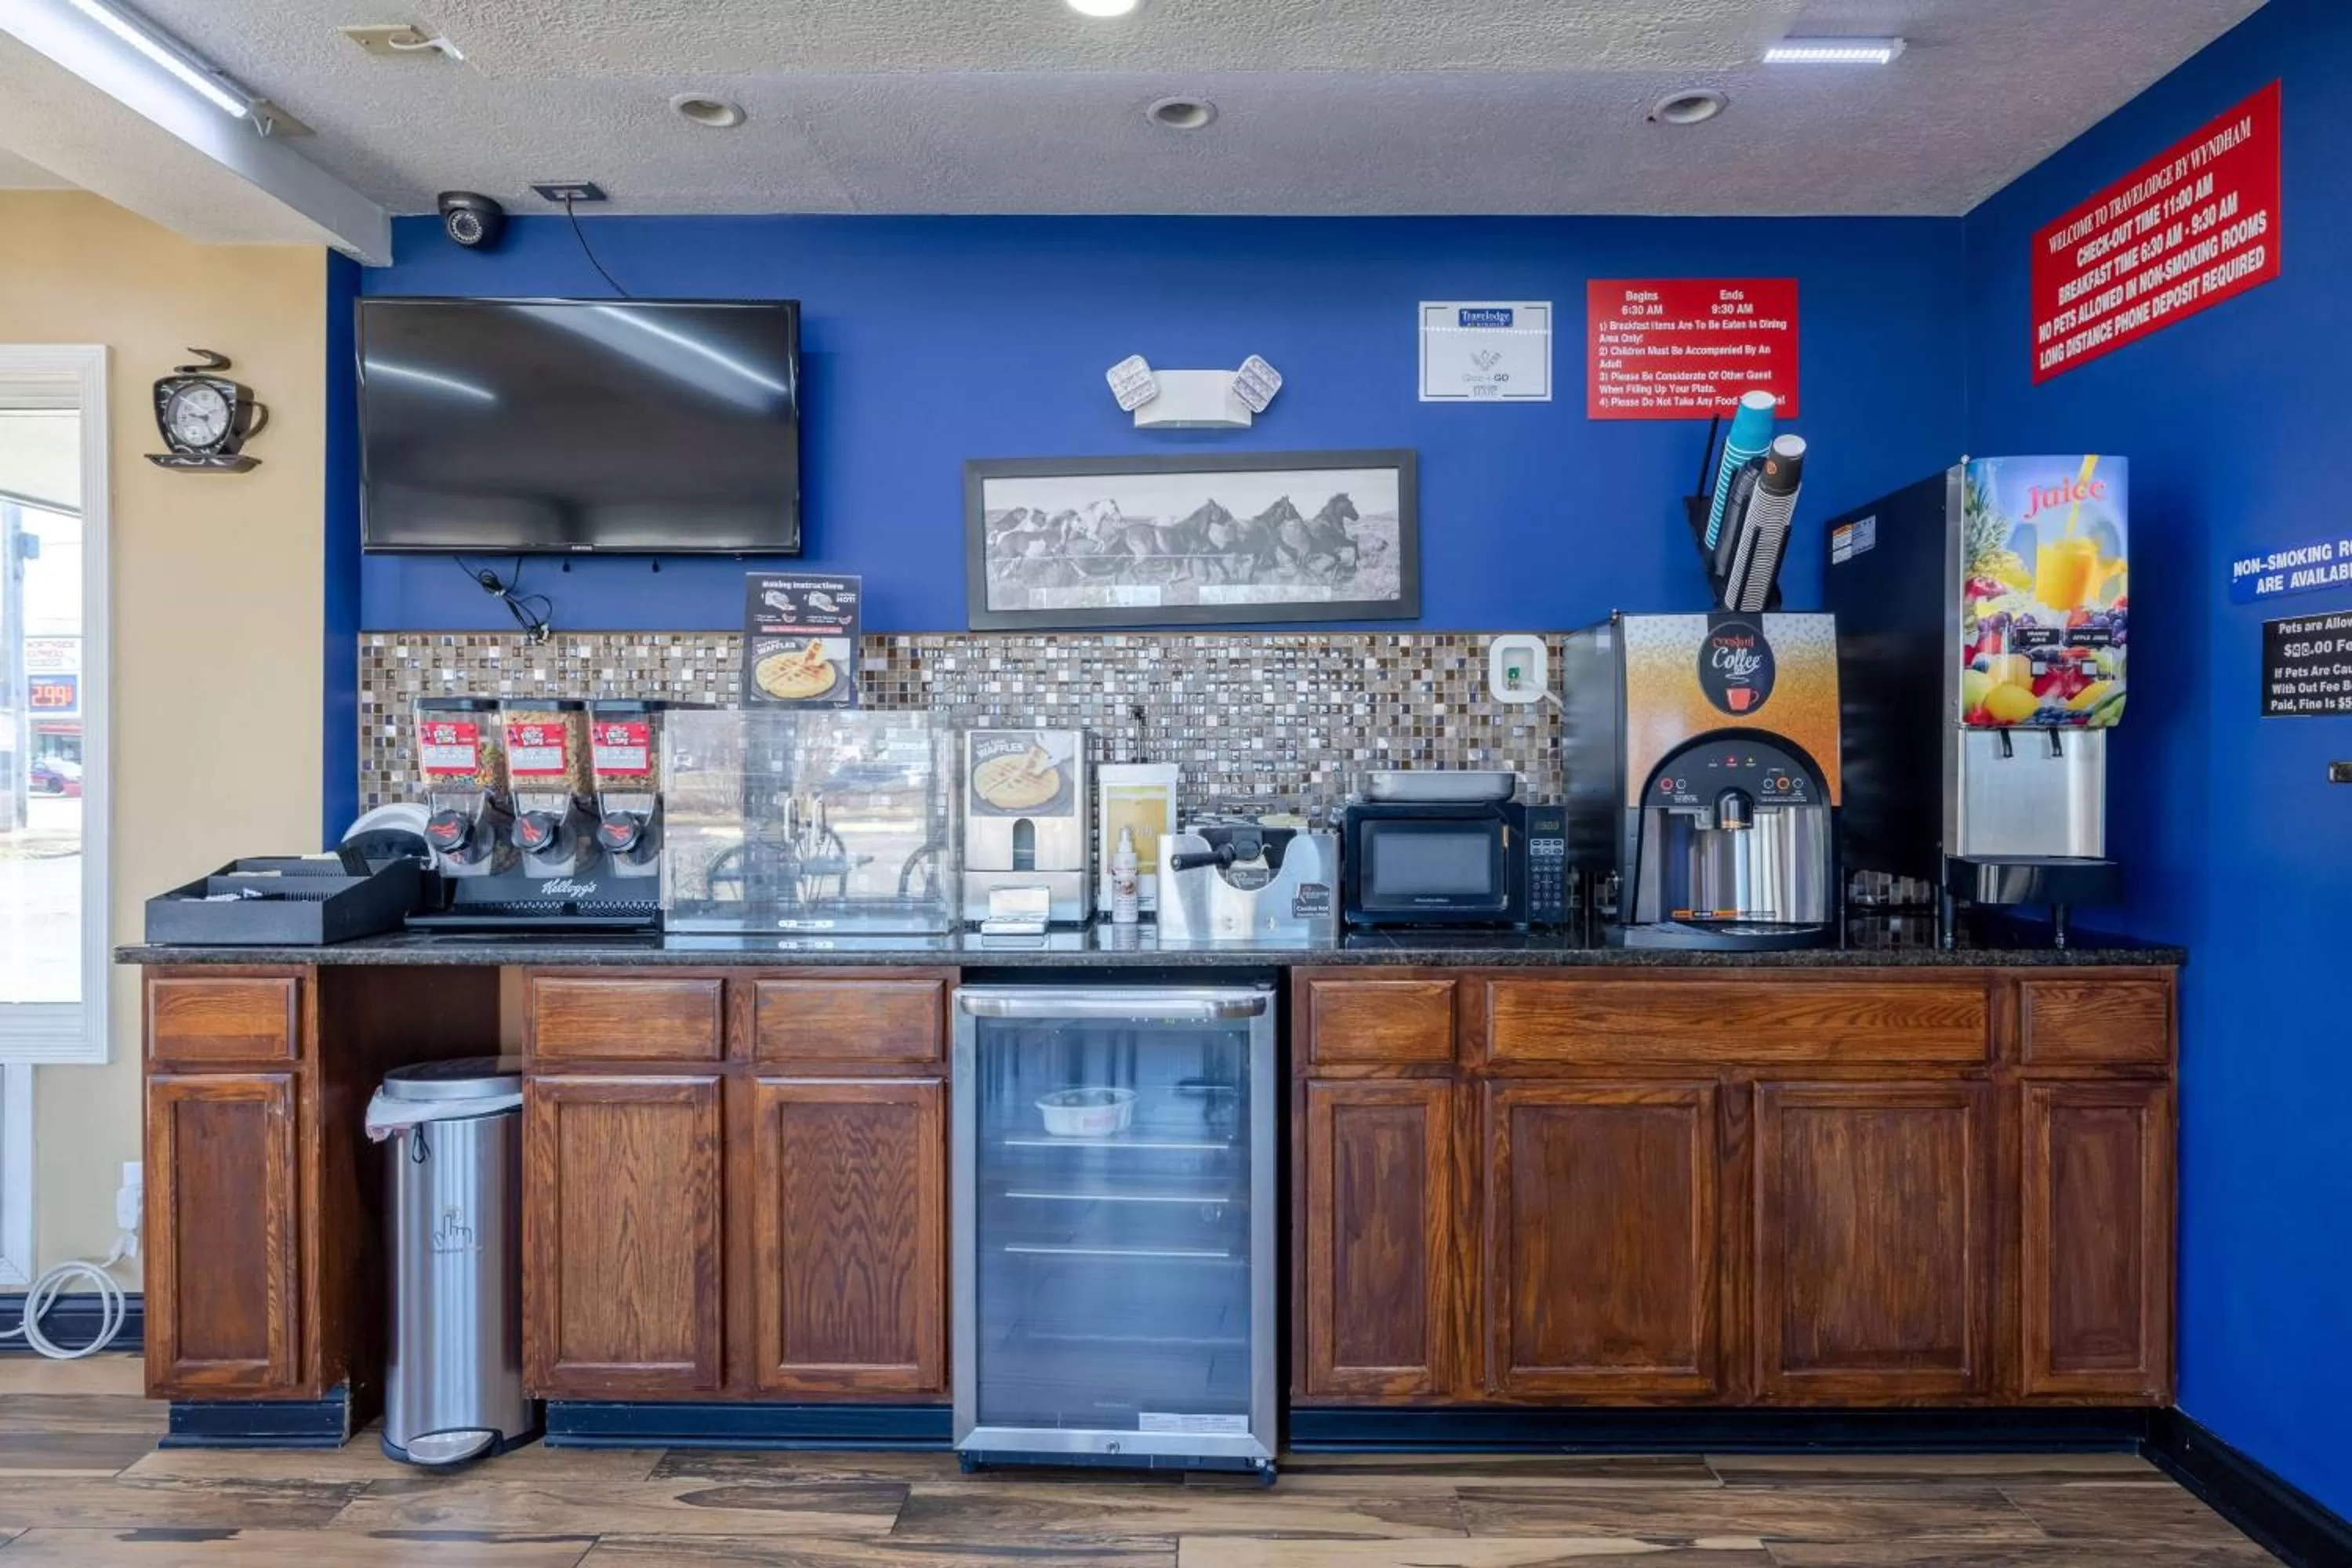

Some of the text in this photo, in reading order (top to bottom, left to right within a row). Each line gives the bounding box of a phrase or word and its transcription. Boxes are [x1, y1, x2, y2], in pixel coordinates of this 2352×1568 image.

[2049, 115, 2251, 254] WELCOME TO TRAVELODGE BY WYNDHAM
[2077, 172, 2213, 267] CHECK-OUT TIME 11:00 AM
[2058, 260, 2113, 306] BREAKFAST
[2114, 246, 2140, 276] TIME
[2141, 234, 2164, 263] 6:30
[2165, 222, 2183, 250] AM
[2191, 204, 2216, 235] 9:30
[2219, 191, 2238, 222] AM
[2038, 209, 2267, 344] NO PETS ALLOWED IN NON-SMOKING ROOMS
[1625, 290, 1658, 303] Begins
[1720, 289, 1744, 299] Ends
[1621, 304, 1663, 315] 6:30 AM
[1711, 303, 1753, 314] 9:30 AM
[2040, 245, 2265, 371] LONG DISTANCE PHONE DEPOSIT REQUIRED
[1461, 309, 1510, 323] Travelodge
[1610, 321, 1650, 330] Breakfast
[1651, 321, 1675, 329] Items
[1678, 320, 1693, 329] Are
[1694, 320, 1706, 329] To
[1708, 320, 1720, 328] Be
[1722, 320, 1747, 328] Eaten
[1749, 320, 1757, 328] In
[1759, 319, 1787, 330] Dining
[1599, 334, 1619, 343] Area
[1610, 346, 1646, 355] Children
[1647, 346, 1669, 355] Must
[1671, 346, 1683, 355] Be
[1685, 345, 1742, 356] Accompanied
[1744, 345, 1756, 356] By
[1759, 345, 1771, 354] An
[1611, 372, 1639, 380] Please
[1642, 372, 1653, 380] Be
[1656, 371, 1706, 380] Considerate
[1708, 371, 1719, 379] Of
[1720, 370, 1744, 379] Other
[1746, 370, 1772, 379] Guest
[1599, 384, 1624, 394] When
[1626, 384, 1652, 395] Filling
[1654, 384, 1667, 395] Up
[1669, 384, 1690, 393] Your
[1611, 397, 1639, 406] Please
[1642, 397, 1654, 406] Do
[1656, 397, 1671, 406] Not
[1674, 397, 1693, 406] Take
[1696, 396, 1713, 408] Any
[1715, 396, 1738, 405] Food
[2024, 476, 2105, 518] Juice
[2234, 540, 2352, 578] NON-SMOKING R
[2256, 574, 2284, 594] ARE
[2279, 622, 2302, 634] Pets
[2305, 621, 2322, 632] are
[1711, 647, 1762, 674] Coffee
[2274, 667, 2283, 678] If
[2285, 667, 2309, 678] Pets
[2310, 665, 2330, 677] Are
[2271, 680, 2352, 695] With Out Fee B
[2270, 699, 2296, 712] Paid,
[2299, 698, 2322, 710] Fine
[2325, 697, 2336, 709] Is
[541, 877, 597, 898] Kellogg's
